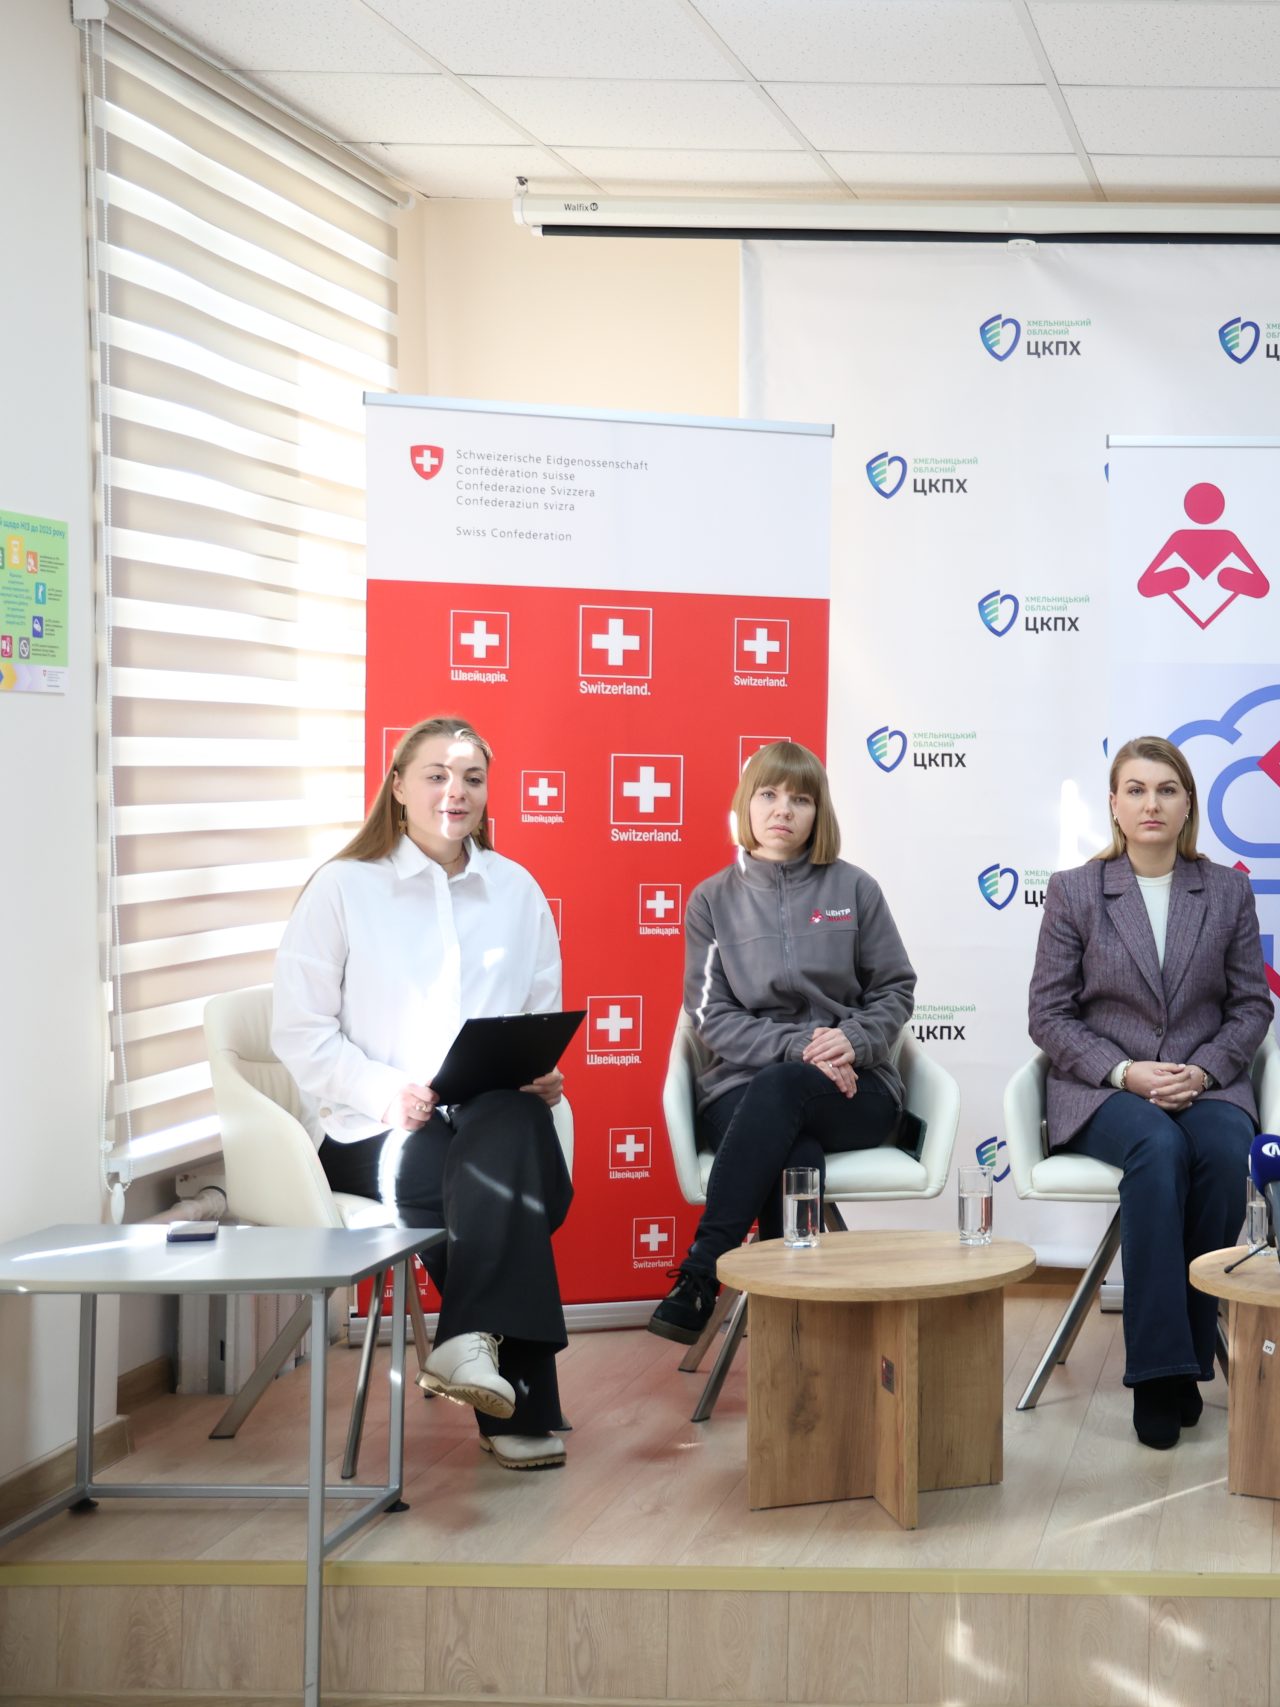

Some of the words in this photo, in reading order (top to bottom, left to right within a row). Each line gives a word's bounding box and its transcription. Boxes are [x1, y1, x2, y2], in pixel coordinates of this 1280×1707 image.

[564, 203, 589, 211] Walfix
[1027, 319, 1091, 327] ХМЕЛЬНИЦЬКИЙ
[1027, 341, 1081, 358] ЦКПХ
[456, 449, 542, 464] Schweizerische
[546, 456, 649, 471] Eidgenossenschaft
[913, 456, 978, 464] ХМЕЛЬНИЦЬКИЙ
[456, 464, 538, 479] Confédération
[542, 471, 575, 481] suisse
[913, 465, 956, 473] ОБЛАСНИЙ
[456, 480, 546, 495] Confederazione
[550, 485, 595, 498] Svizzera
[913, 479, 968, 495] ЦКПХ
[456, 496, 540, 510] Confederaziun
[543, 500, 575, 511] svizra
[456, 527, 487, 538] Swiss
[491, 528, 572, 541] Confederation
[1025, 594, 1090, 603] ХМЕЛЬНИЦЬКИЙ
[1025, 617, 1079, 634] ЦКПХ
[451, 669, 508, 683] Швейцарія.
[733, 675, 788, 687] Switzerland.
[579, 680, 651, 696] Switzerland.
[913, 731, 977, 740] ХМЕЛЬНИЦЬКИЙ
[913, 753, 966, 770] ЦКПХ
[611, 828, 682, 842] Switzerland.
[639, 926, 680, 936] Швейцарія.
[586, 1053, 642, 1066] Швейцарія.
[609, 1169, 650, 1180] Швейцарія.
[633, 1258, 674, 1269] Switzerland.
